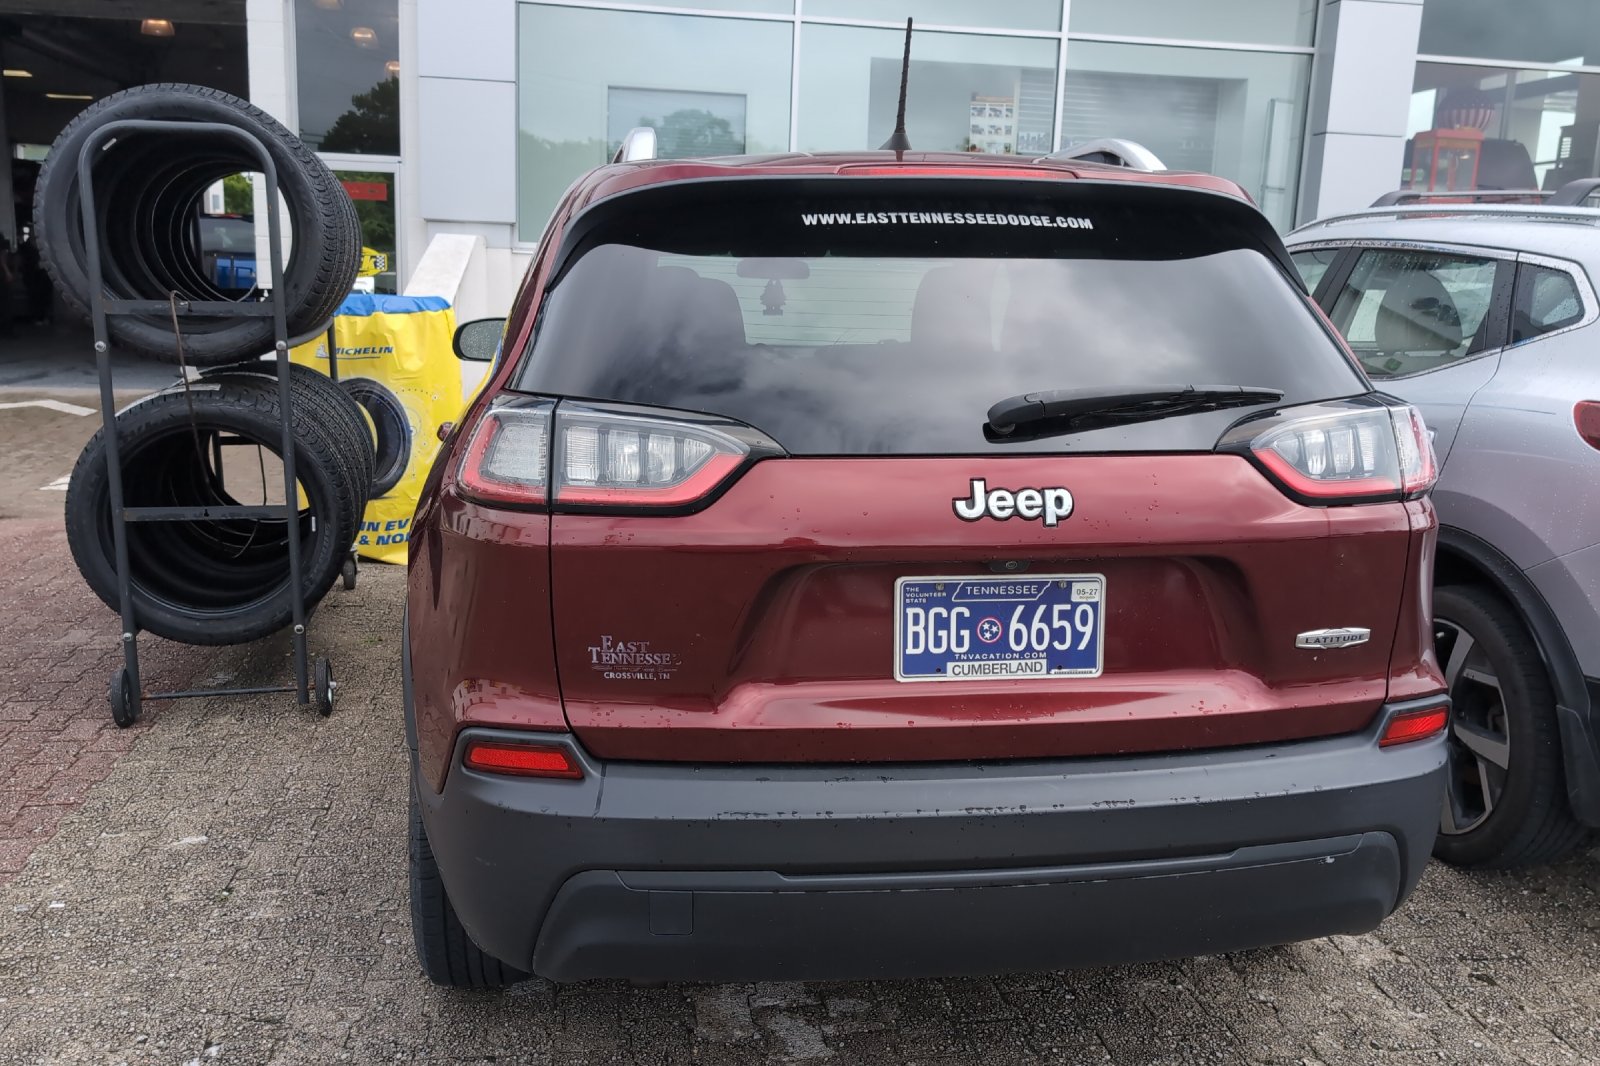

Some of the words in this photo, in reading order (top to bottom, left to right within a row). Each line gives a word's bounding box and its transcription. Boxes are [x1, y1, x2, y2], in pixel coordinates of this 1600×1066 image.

[801, 212, 1094, 230] WWW.EASTTENNESSEEDODGE.COM
[952, 477, 1074, 528] Jeep
[359, 535, 369, 545] &
[965, 585, 1039, 595] TENNESSEE
[1076, 588, 1099, 596] 05-27
[905, 607, 970, 655] BGG
[1008, 604, 1095, 652] 6659
[601, 635, 650, 653] EAST
[1305, 633, 1365, 644] LATITUDE
[954, 652, 1047, 660] TNVACATION.COM
[951, 661, 1043, 676] CUMBERLAND
[603, 671, 657, 681] CROSSVILLE,
[658, 672, 670, 680] TN
